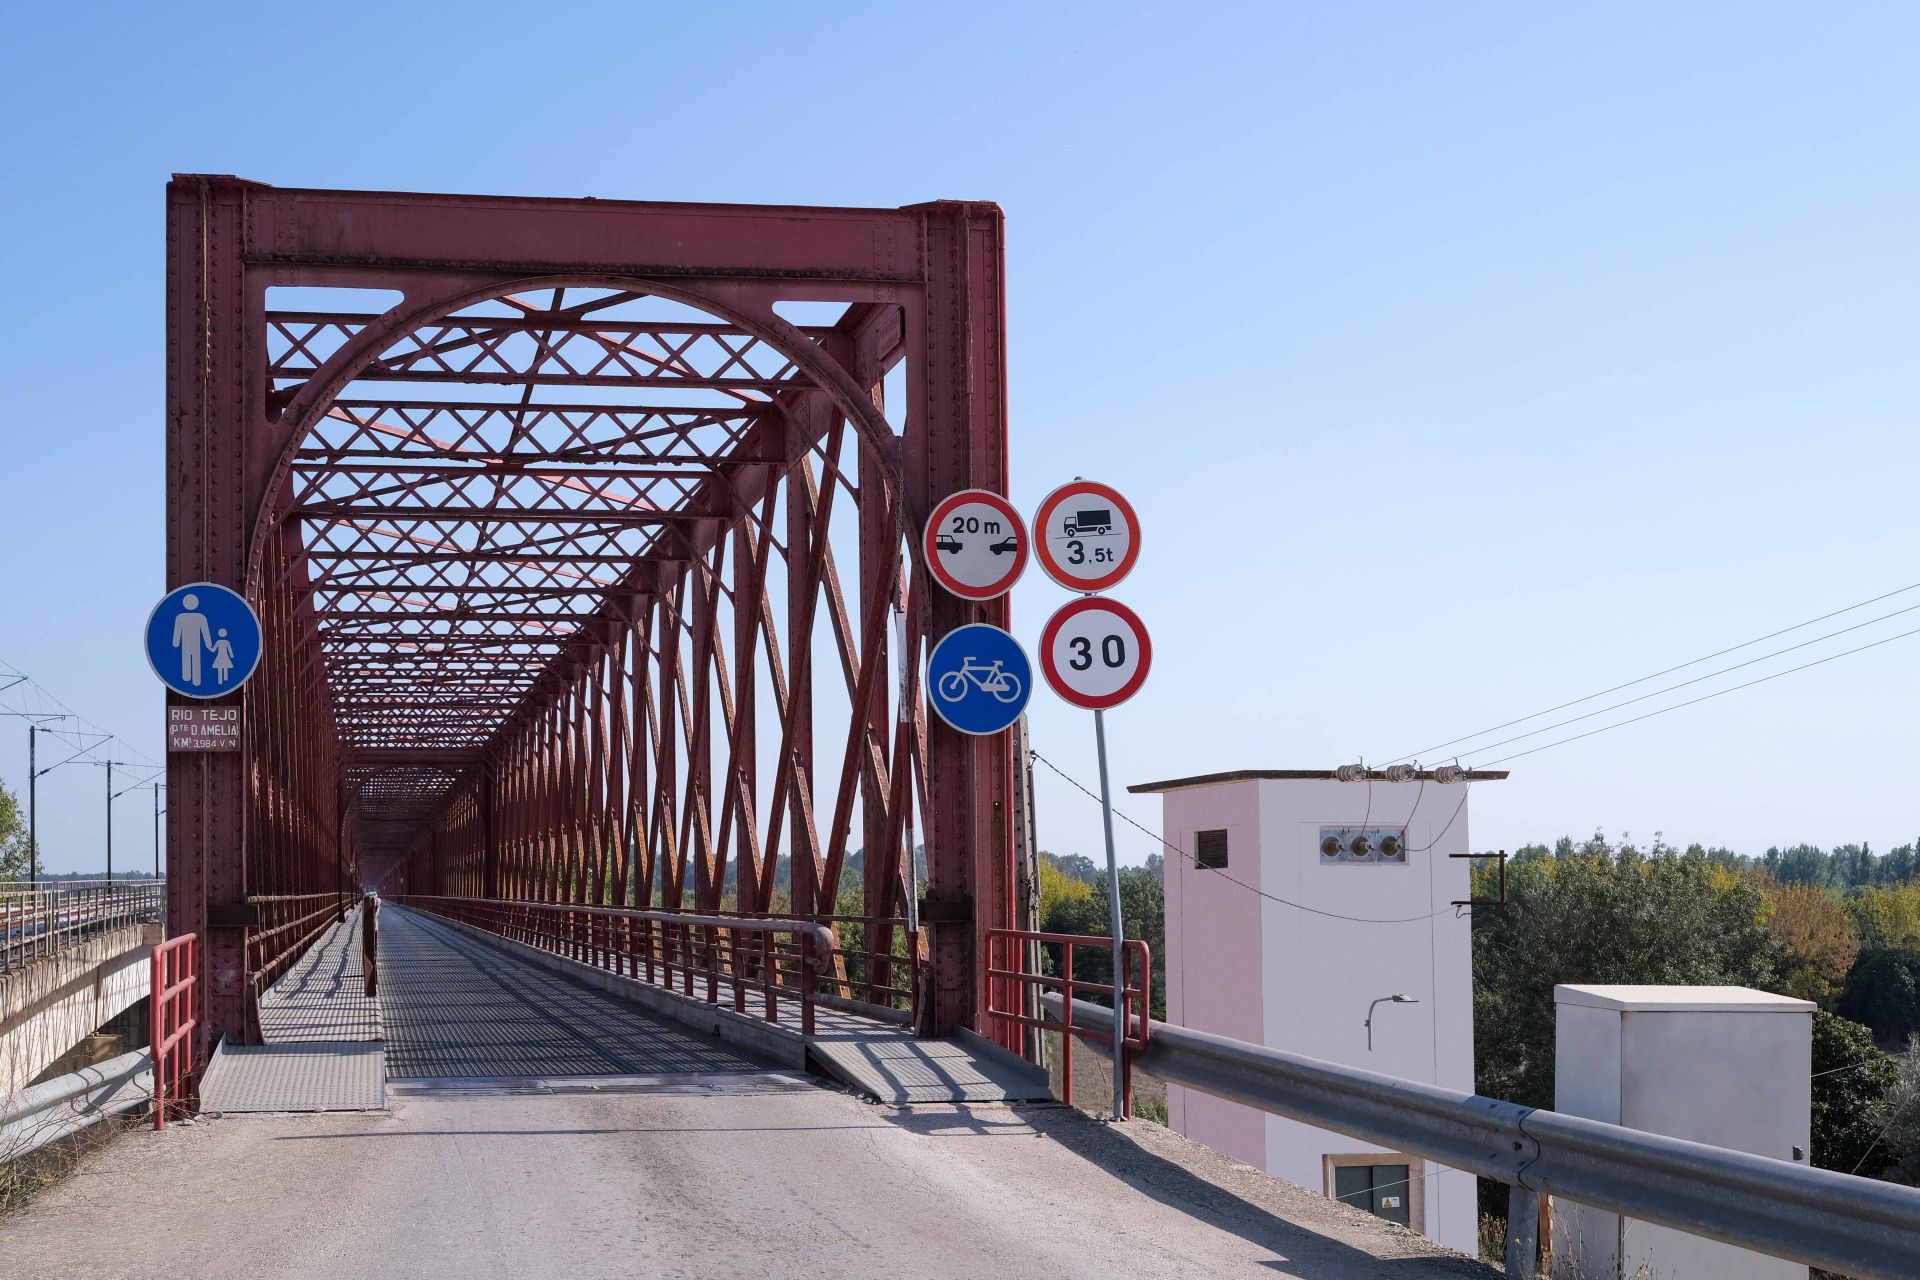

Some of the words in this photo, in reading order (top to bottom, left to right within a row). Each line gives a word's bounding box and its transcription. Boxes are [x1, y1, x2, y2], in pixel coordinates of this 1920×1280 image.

[952, 516, 979, 534] 20
[983, 520, 1001, 535] m
[1069, 634, 1126, 671] 30
[171, 709, 193, 721] RIO
[200, 709, 237, 721] TEJO
